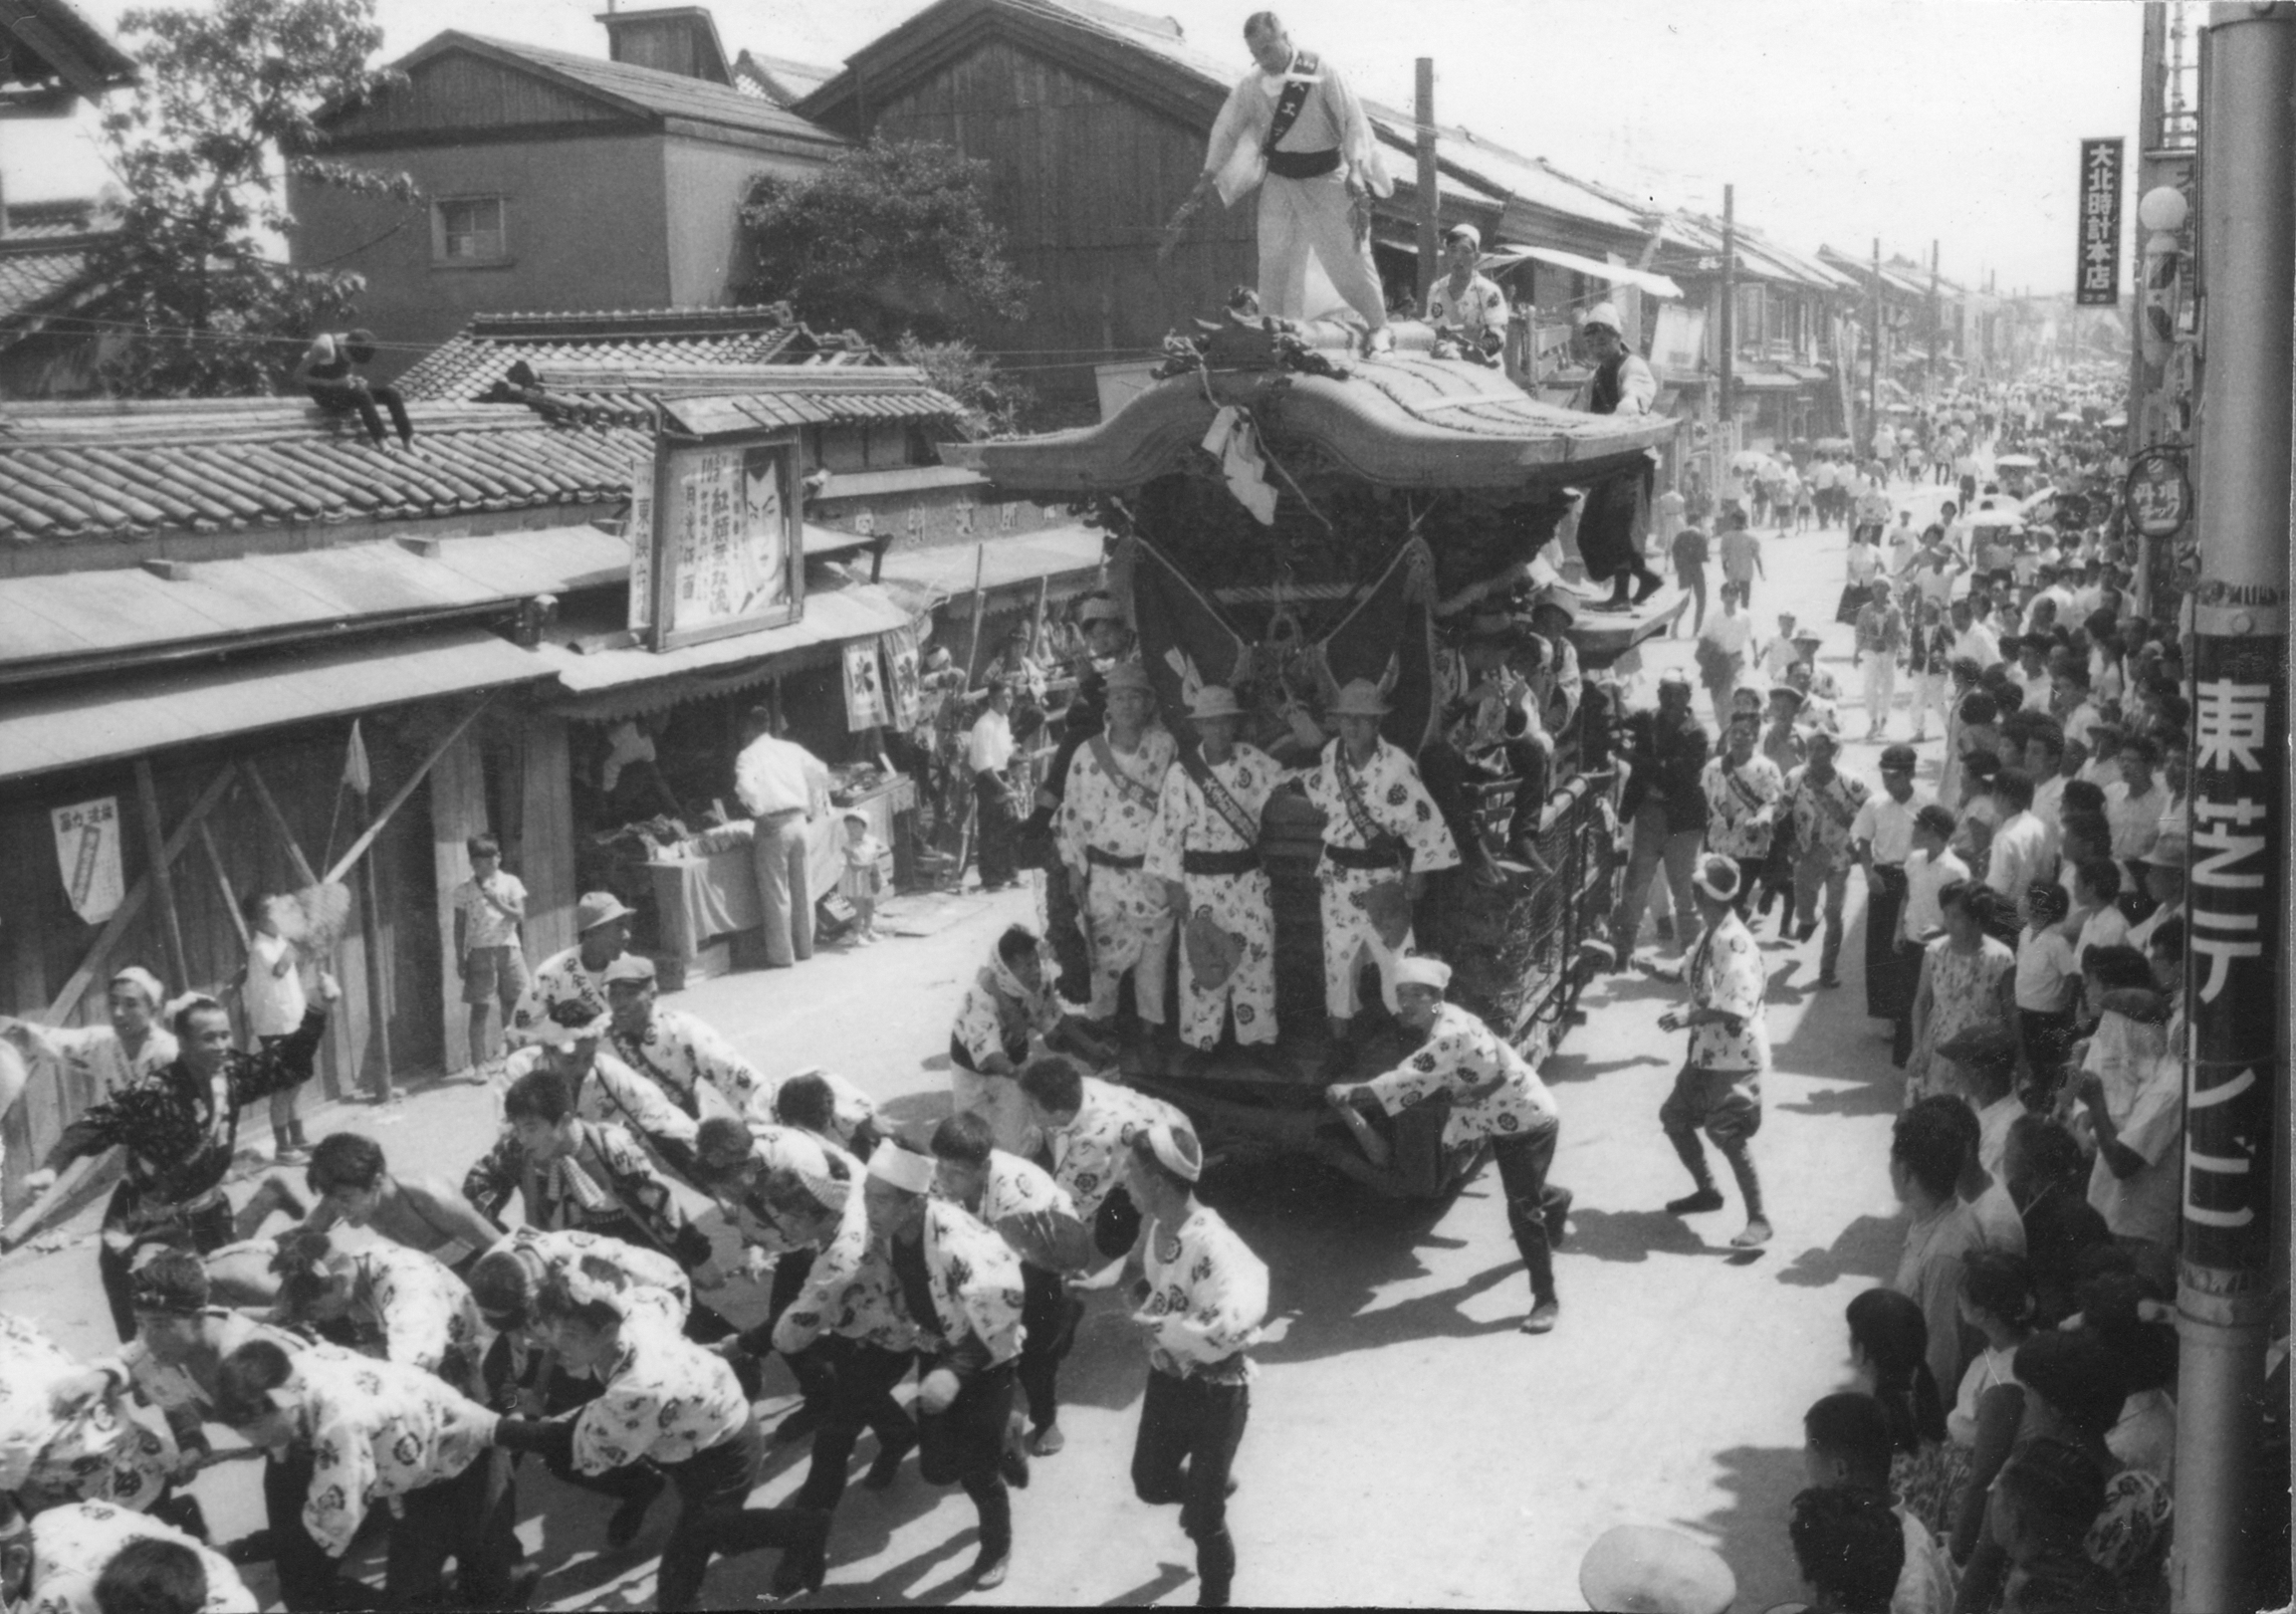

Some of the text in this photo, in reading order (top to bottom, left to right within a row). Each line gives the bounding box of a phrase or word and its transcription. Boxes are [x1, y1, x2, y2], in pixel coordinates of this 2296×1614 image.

[2084, 143, 2115, 291] 大北時計本店
[2181, 678, 2270, 1229] 東芝テレビ
